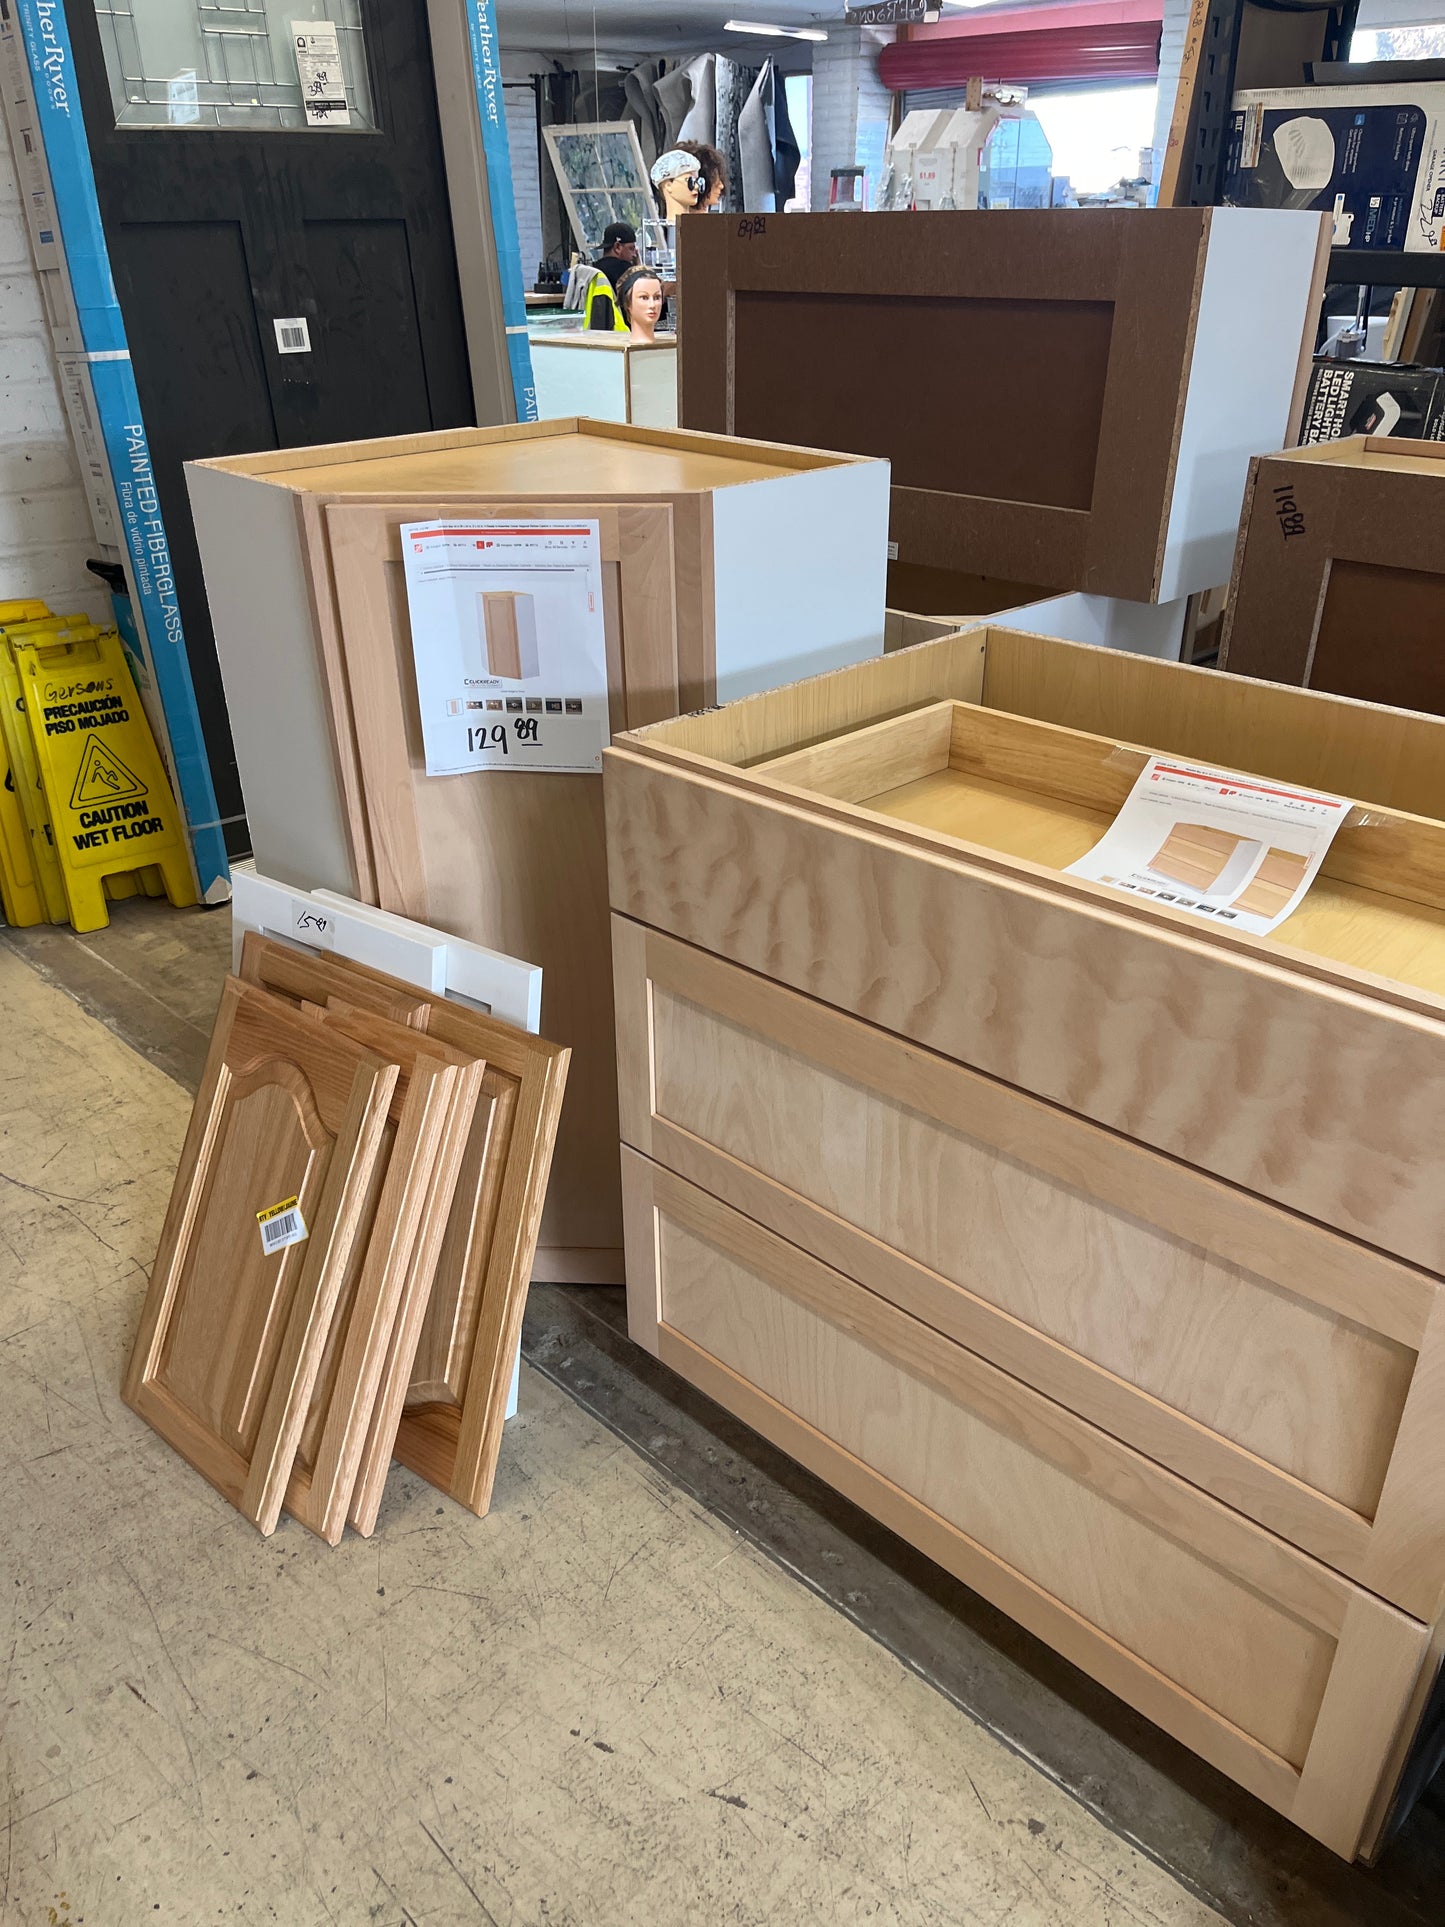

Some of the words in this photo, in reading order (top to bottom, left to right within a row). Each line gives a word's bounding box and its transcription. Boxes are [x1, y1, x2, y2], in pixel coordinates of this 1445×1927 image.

[30, 41, 41, 72] GLASS
[1429, 149, 1437, 172] GARAGE
[1330, 371, 1344, 395] LED
[1336, 371, 1354, 417] SMART
[1312, 369, 1333, 427] BATTERY
[120, 481, 132, 509] Fibra
[127, 511, 137, 524] de
[123, 424, 158, 514] PAINTED
[144, 519, 183, 644] FIBERGLASS
[130, 526, 143, 555] vidrio
[135, 556, 151, 595] pintada
[44, 694, 123, 721] PRECAUCIÓN
[45, 722, 76, 736] PISO
[78, 710, 130, 730] MOJADO
[467, 724, 509, 754] 129
[513, 718, 543, 746] 89
[79, 800, 149, 829] CAUTION
[73, 829, 109, 851] WET
[113, 817, 165, 845] FLOOR
